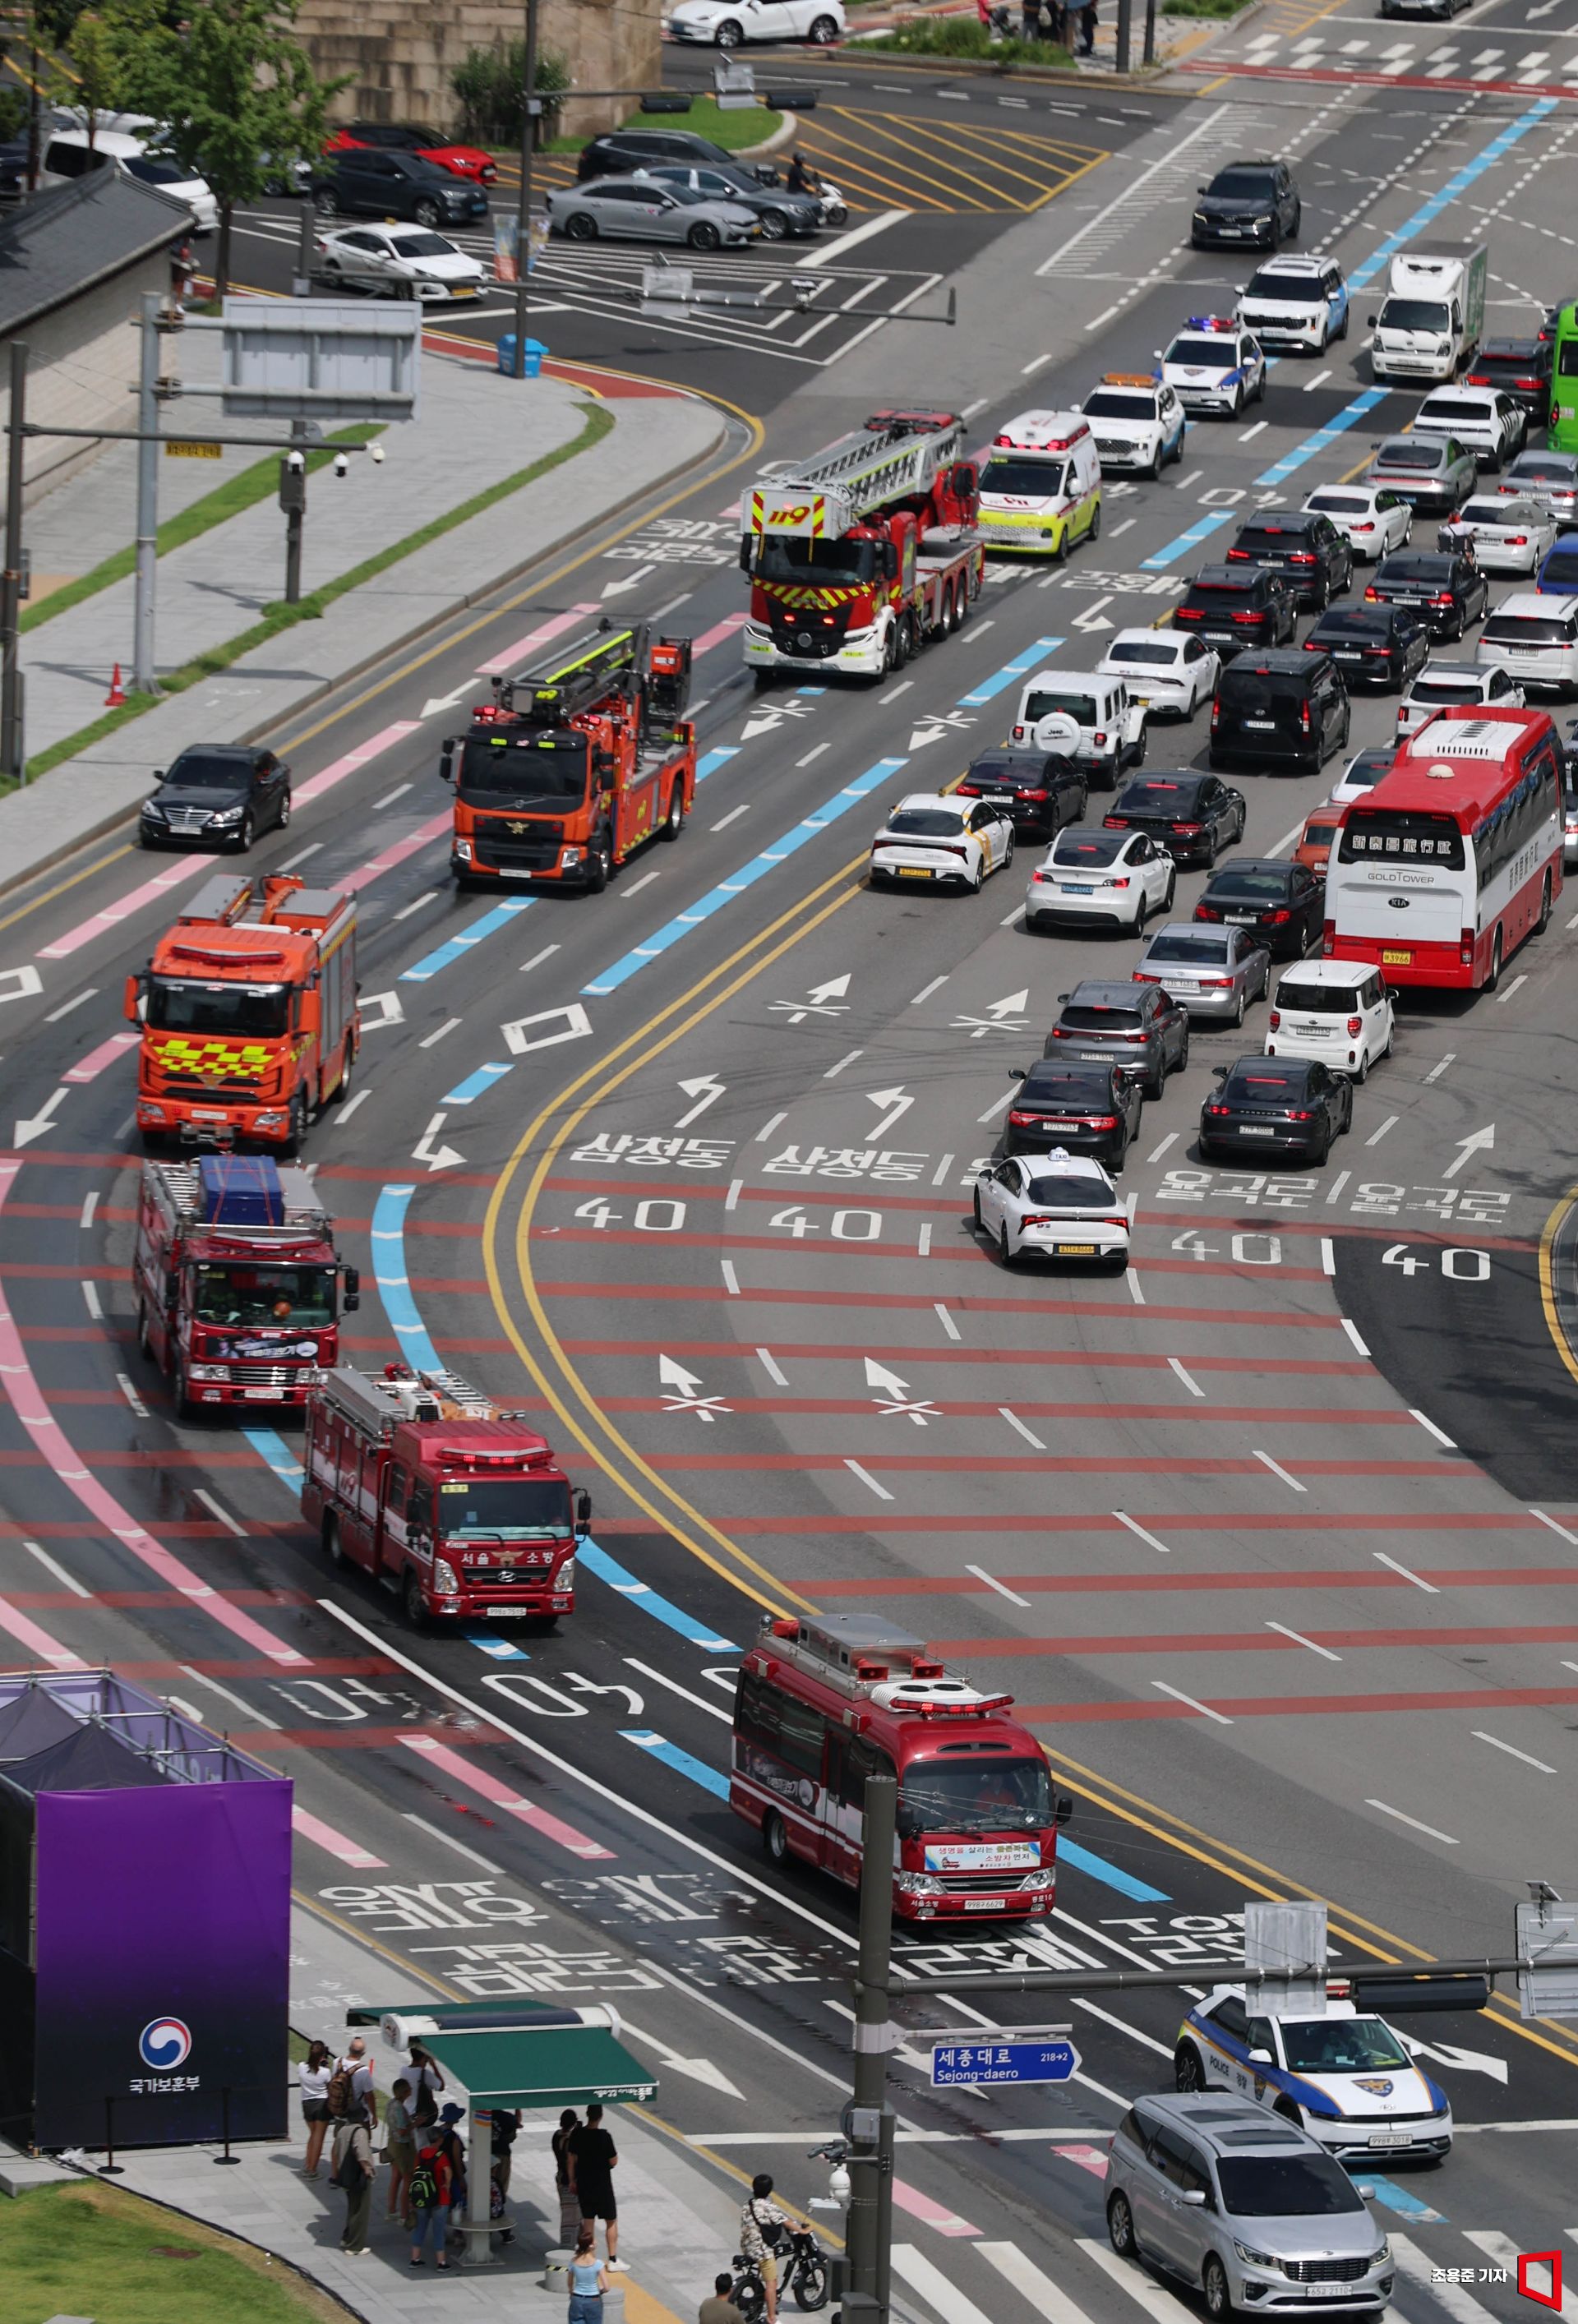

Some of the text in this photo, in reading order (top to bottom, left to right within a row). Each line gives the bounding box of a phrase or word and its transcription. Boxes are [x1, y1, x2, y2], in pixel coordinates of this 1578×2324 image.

[768, 505, 811, 526] 119
[636, 519, 743, 543] 자동
[1391, 899, 1407, 907] KIA
[569, 1132, 736, 1169] 삼청동
[761, 1145, 930, 1182] 삼청동
[1155, 1170, 1319, 1208] 율곡로
[574, 1197, 687, 1231] 40
[1350, 1183, 1511, 1224] 율곡로
[768, 1206, 883, 1241] 40
[1171, 1230, 1283, 1266] 40
[1382, 1243, 1492, 1281] 40
[461, 1551, 555, 1565] 서울 소방
[480, 1672, 645, 1718] 40
[939, 1847, 965, 1855] 생명을
[968, 1845, 994, 1854] 살리는
[985, 1853, 1030, 1862] 소방차 먼저
[911, 1900, 939, 1908] 서울소방
[408, 1942, 665, 1995] 독립문
[938, 2047, 1012, 2068] 세종대로
[1210, 2054, 1230, 2077] POLICE
[129, 2075, 201, 2094] 국가보훈부
[937, 2068, 1019, 2083] Sejong-daero
